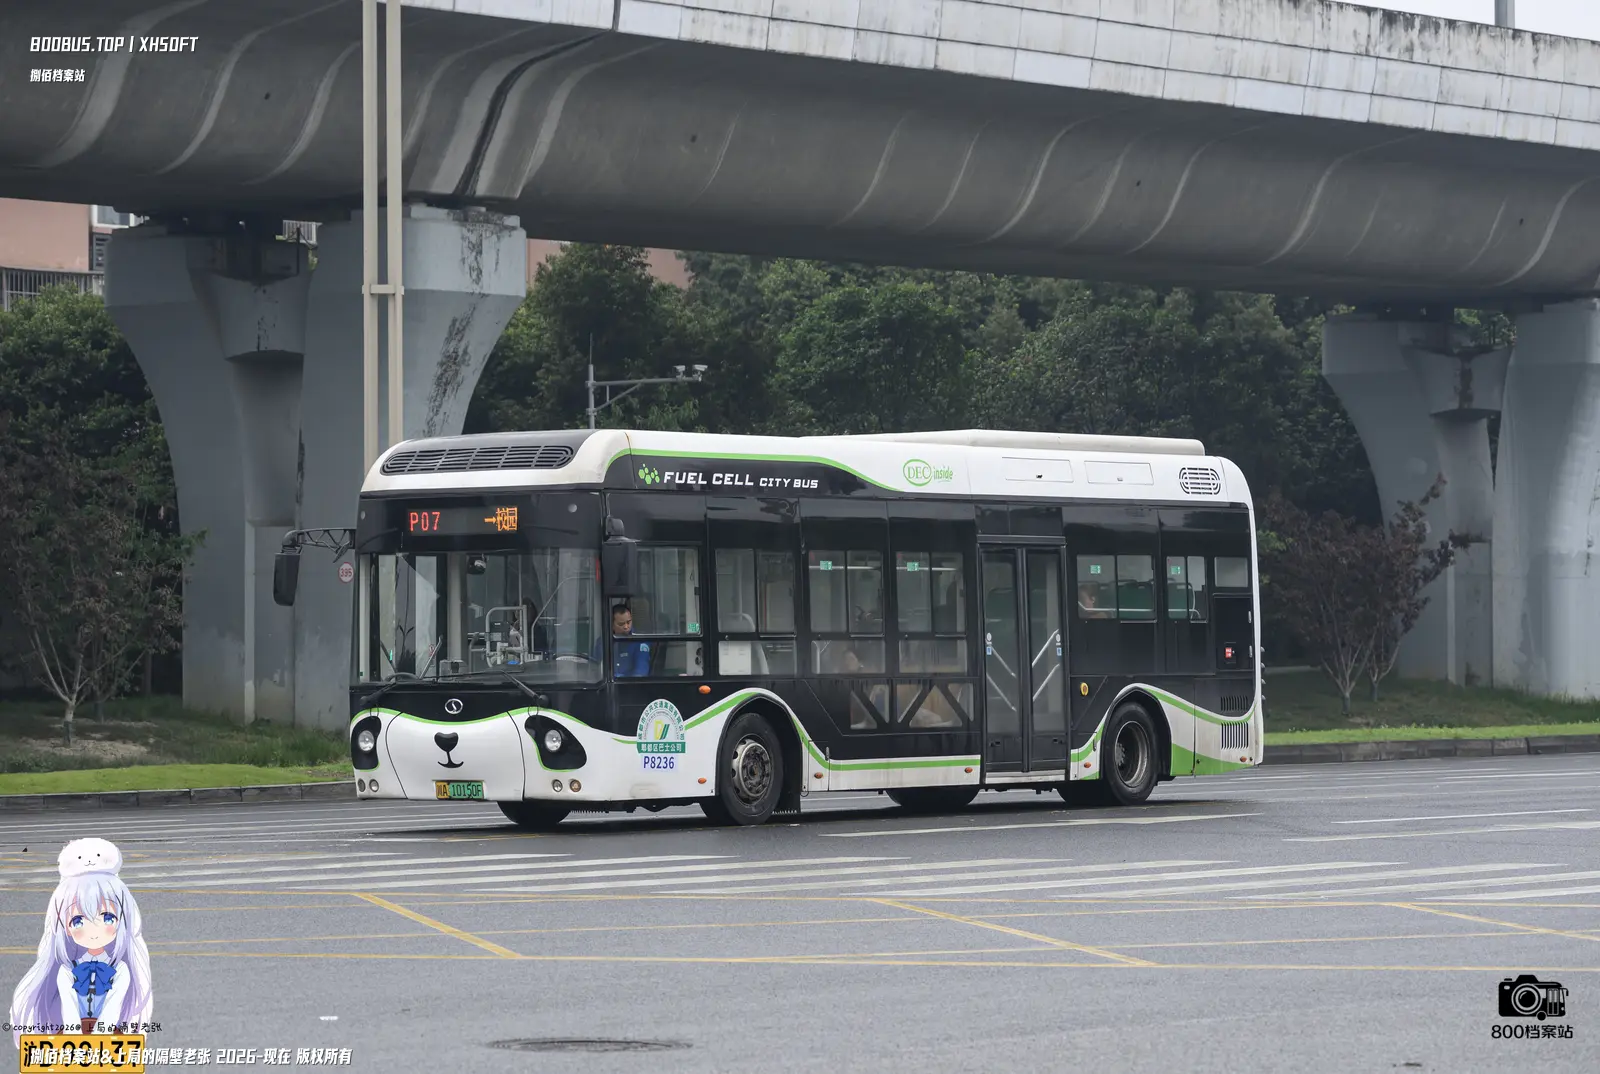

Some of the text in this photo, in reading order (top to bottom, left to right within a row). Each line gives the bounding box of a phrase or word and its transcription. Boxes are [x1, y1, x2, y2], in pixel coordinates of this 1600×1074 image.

[663, 471, 819, 489] FUEL CELL CITY BUS
[907, 465, 953, 480] DEC inside
[409, 511, 441, 532] P07
[496, 507, 518, 531] 校园
[643, 756, 675, 769] P8236
